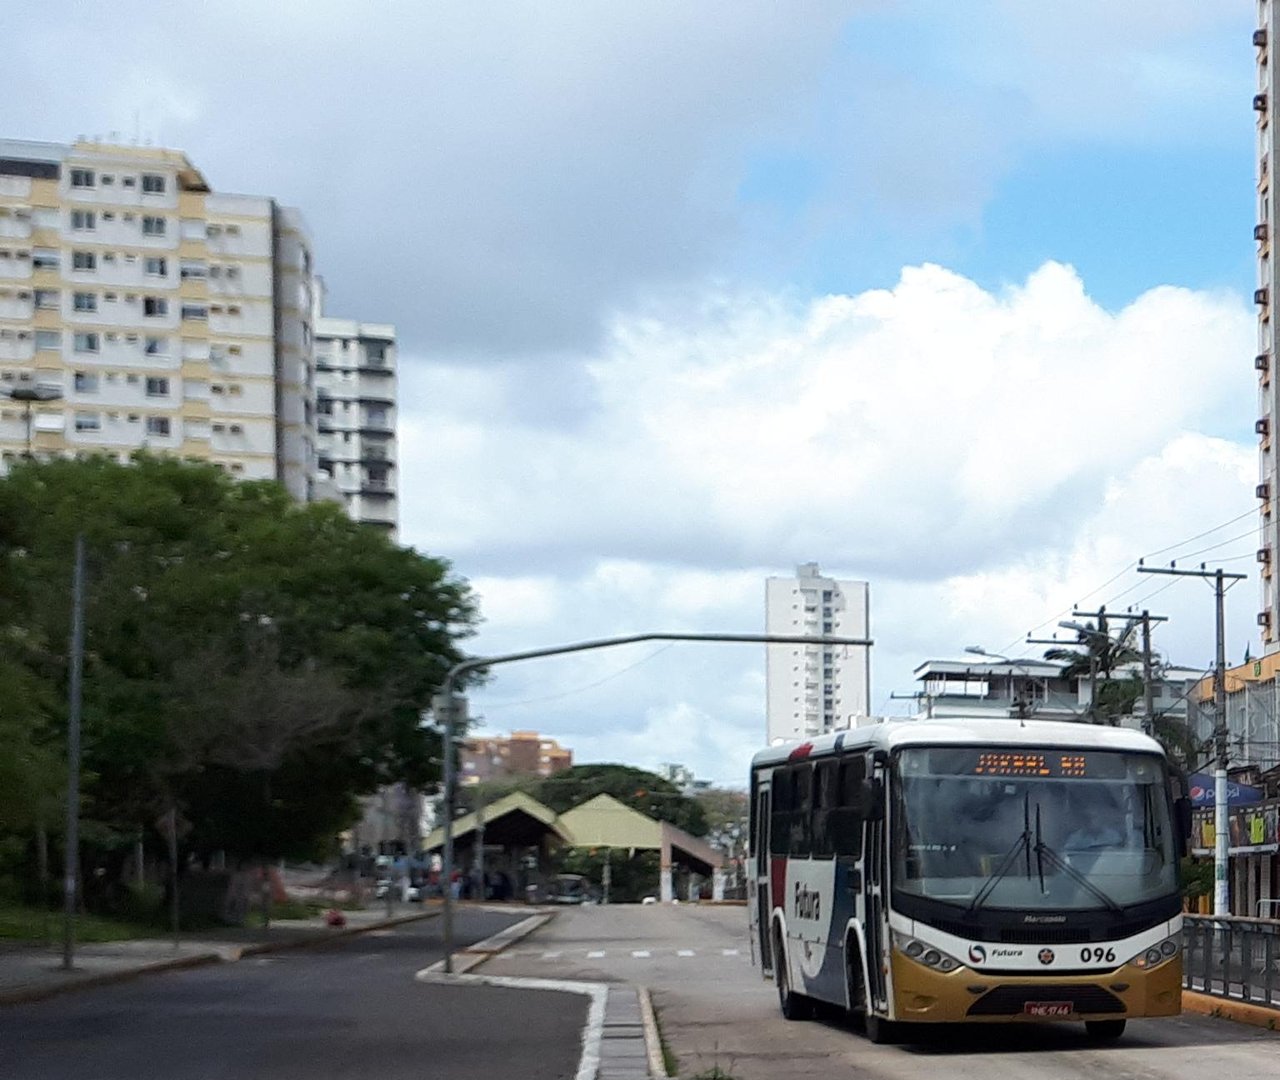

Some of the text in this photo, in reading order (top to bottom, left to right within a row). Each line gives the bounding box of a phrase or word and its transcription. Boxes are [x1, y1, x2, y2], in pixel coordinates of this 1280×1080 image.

[1206, 786, 1240, 801] ppsi
[991, 948, 1023, 957] Futura
[1080, 946, 1116, 963] 096
